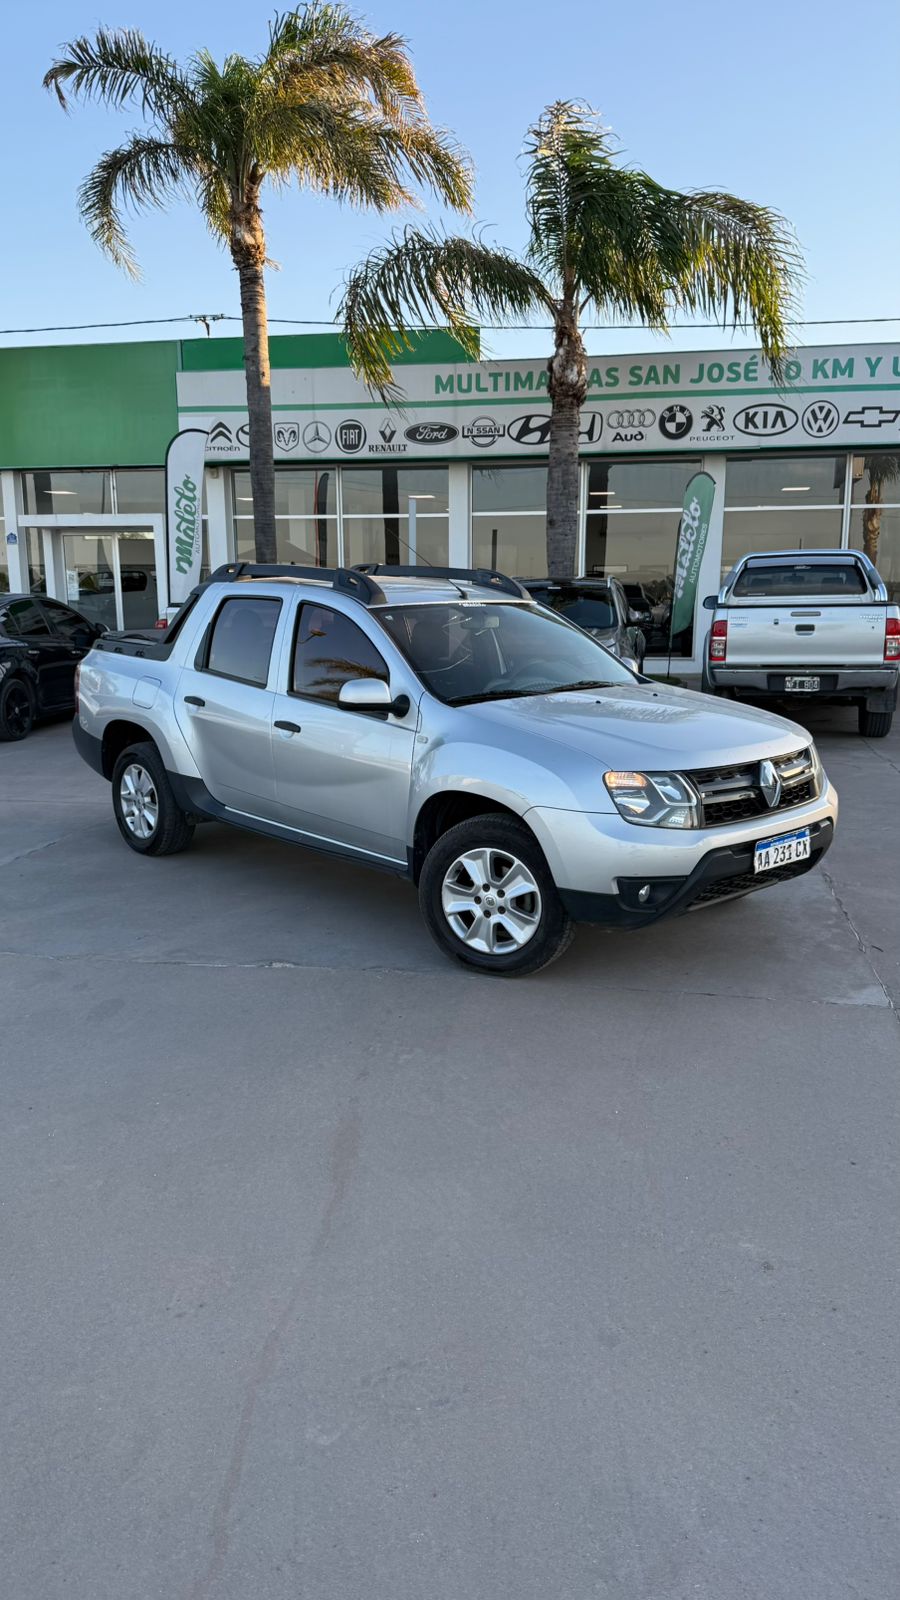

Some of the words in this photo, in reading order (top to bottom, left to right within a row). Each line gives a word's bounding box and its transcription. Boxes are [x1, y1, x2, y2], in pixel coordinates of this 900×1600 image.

[434, 367, 620, 395] MULTIMAAS
[628, 364, 681, 387] SAN
[689, 355, 759, 384] JOSÉ
[812, 357, 855, 379] KM
[864, 356, 883, 378] Y
[744, 410, 788, 430] KIA
[341, 429, 360, 447] FIAT
[415, 424, 448, 440] Ford
[466, 426, 501, 435] NSSAN
[689, 434, 736, 442] PEUGEOT
[368, 444, 408, 453] RENAULT
[689, 522, 708, 584] AUTOMOTORES
[757, 851, 770, 870] AA
[773, 844, 792, 864] 231
[795, 839, 809, 858] CX
